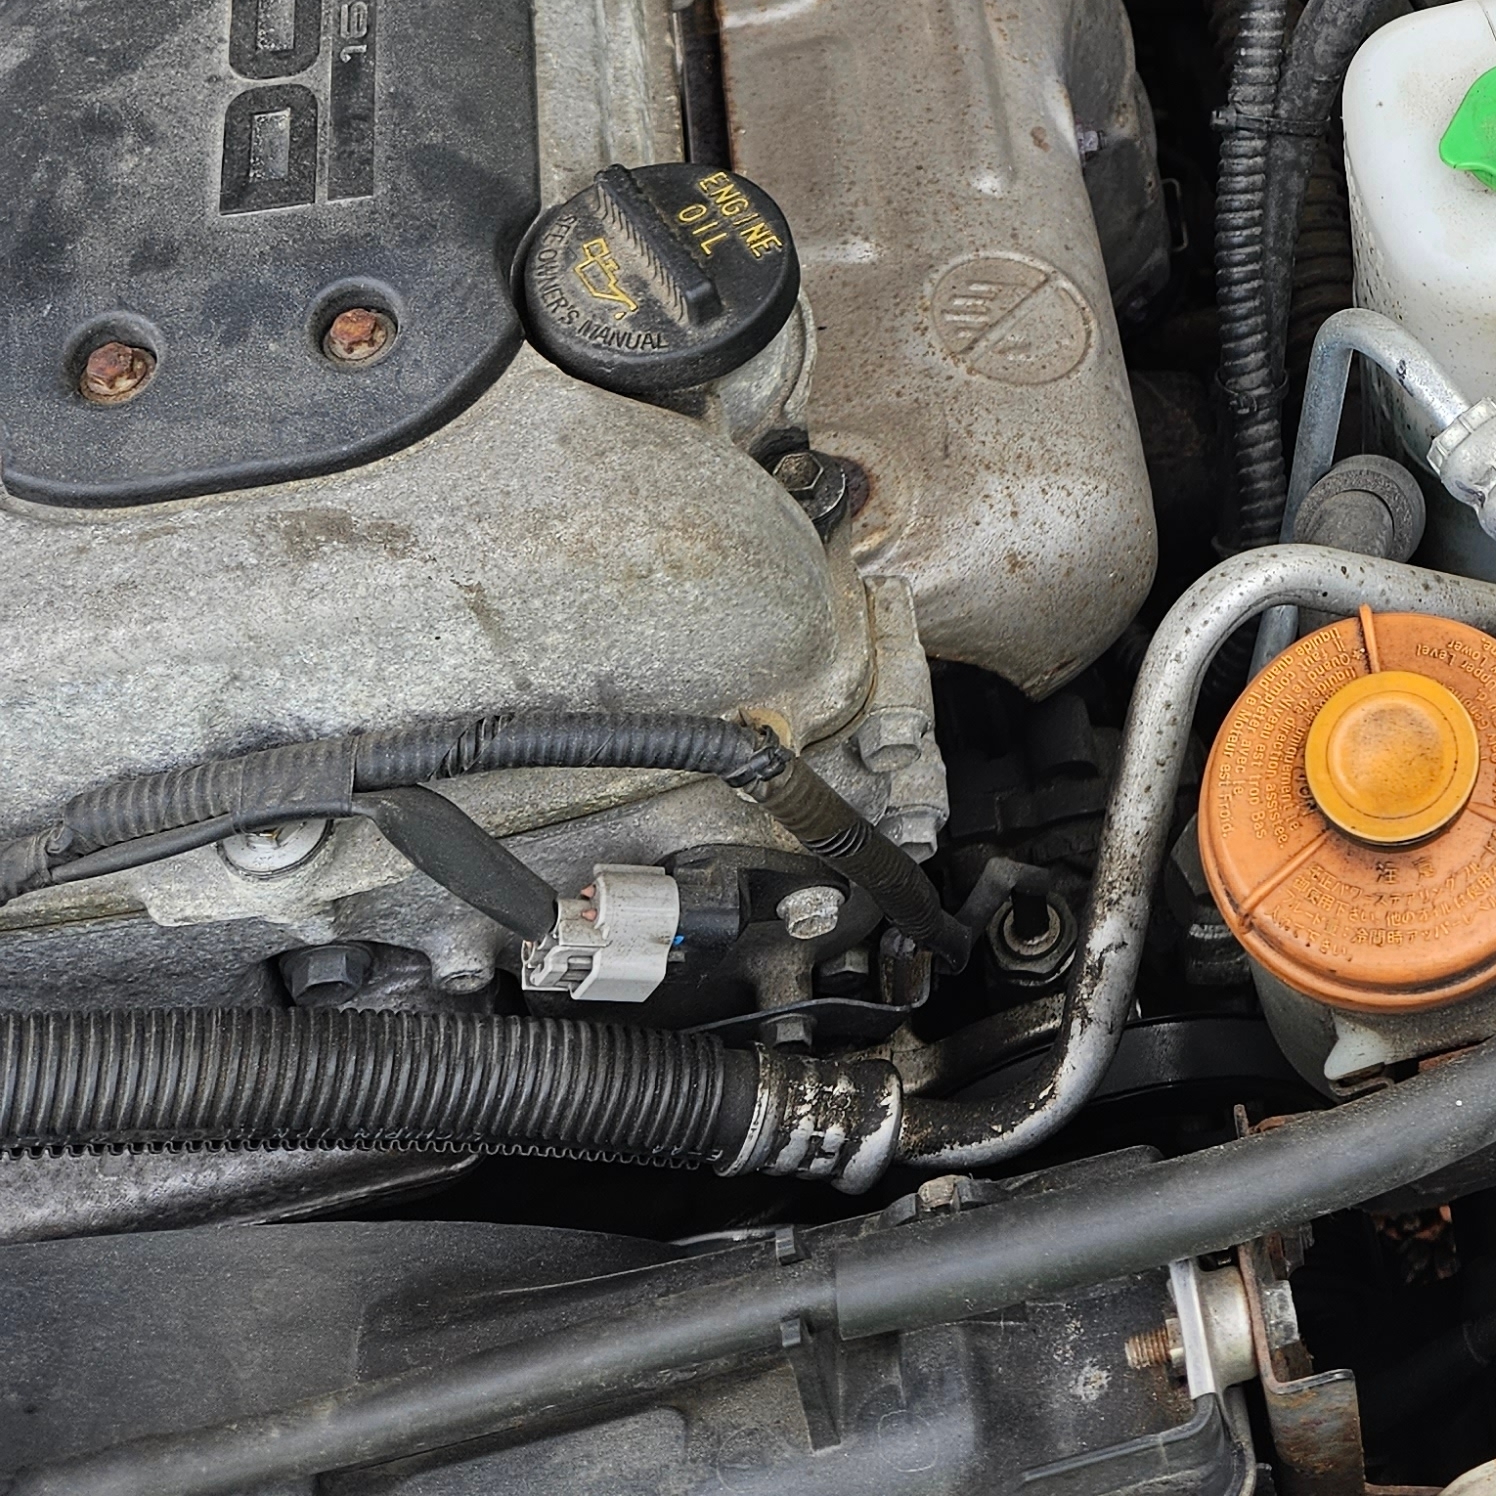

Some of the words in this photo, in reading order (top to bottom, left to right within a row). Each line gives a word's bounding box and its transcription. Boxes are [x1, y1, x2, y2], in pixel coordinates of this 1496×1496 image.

[543, 214, 578, 247] SEE
[678, 203, 728, 255] OIL
[699, 171, 783, 259] ENGINE
[536, 248, 580, 325] OWNER'S
[577, 319, 669, 350] MANUAL
[1295, 628, 1341, 656] liquide
[1416, 644, 1457, 666] Level
[1447, 639, 1487, 667] Lower
[1258, 655, 1293, 691] quand
[1299, 648, 1329, 671] faut
[1307, 652, 1350, 683] Quand
[1310, 667, 1356, 698] liquide
[1246, 691, 1261, 706] le
[1246, 670, 1296, 732] completer
[1295, 697, 1310, 715] de
[1260, 693, 1295, 739] Niveau
[1223, 709, 1252, 758] Moteur
[1266, 716, 1295, 779] direction
[1235, 738, 1252, 774] avec
[1251, 744, 1266, 767] est
[1218, 763, 1231, 787] est
[1233, 779, 1246, 795] le
[1251, 810, 1267, 839] Bas
